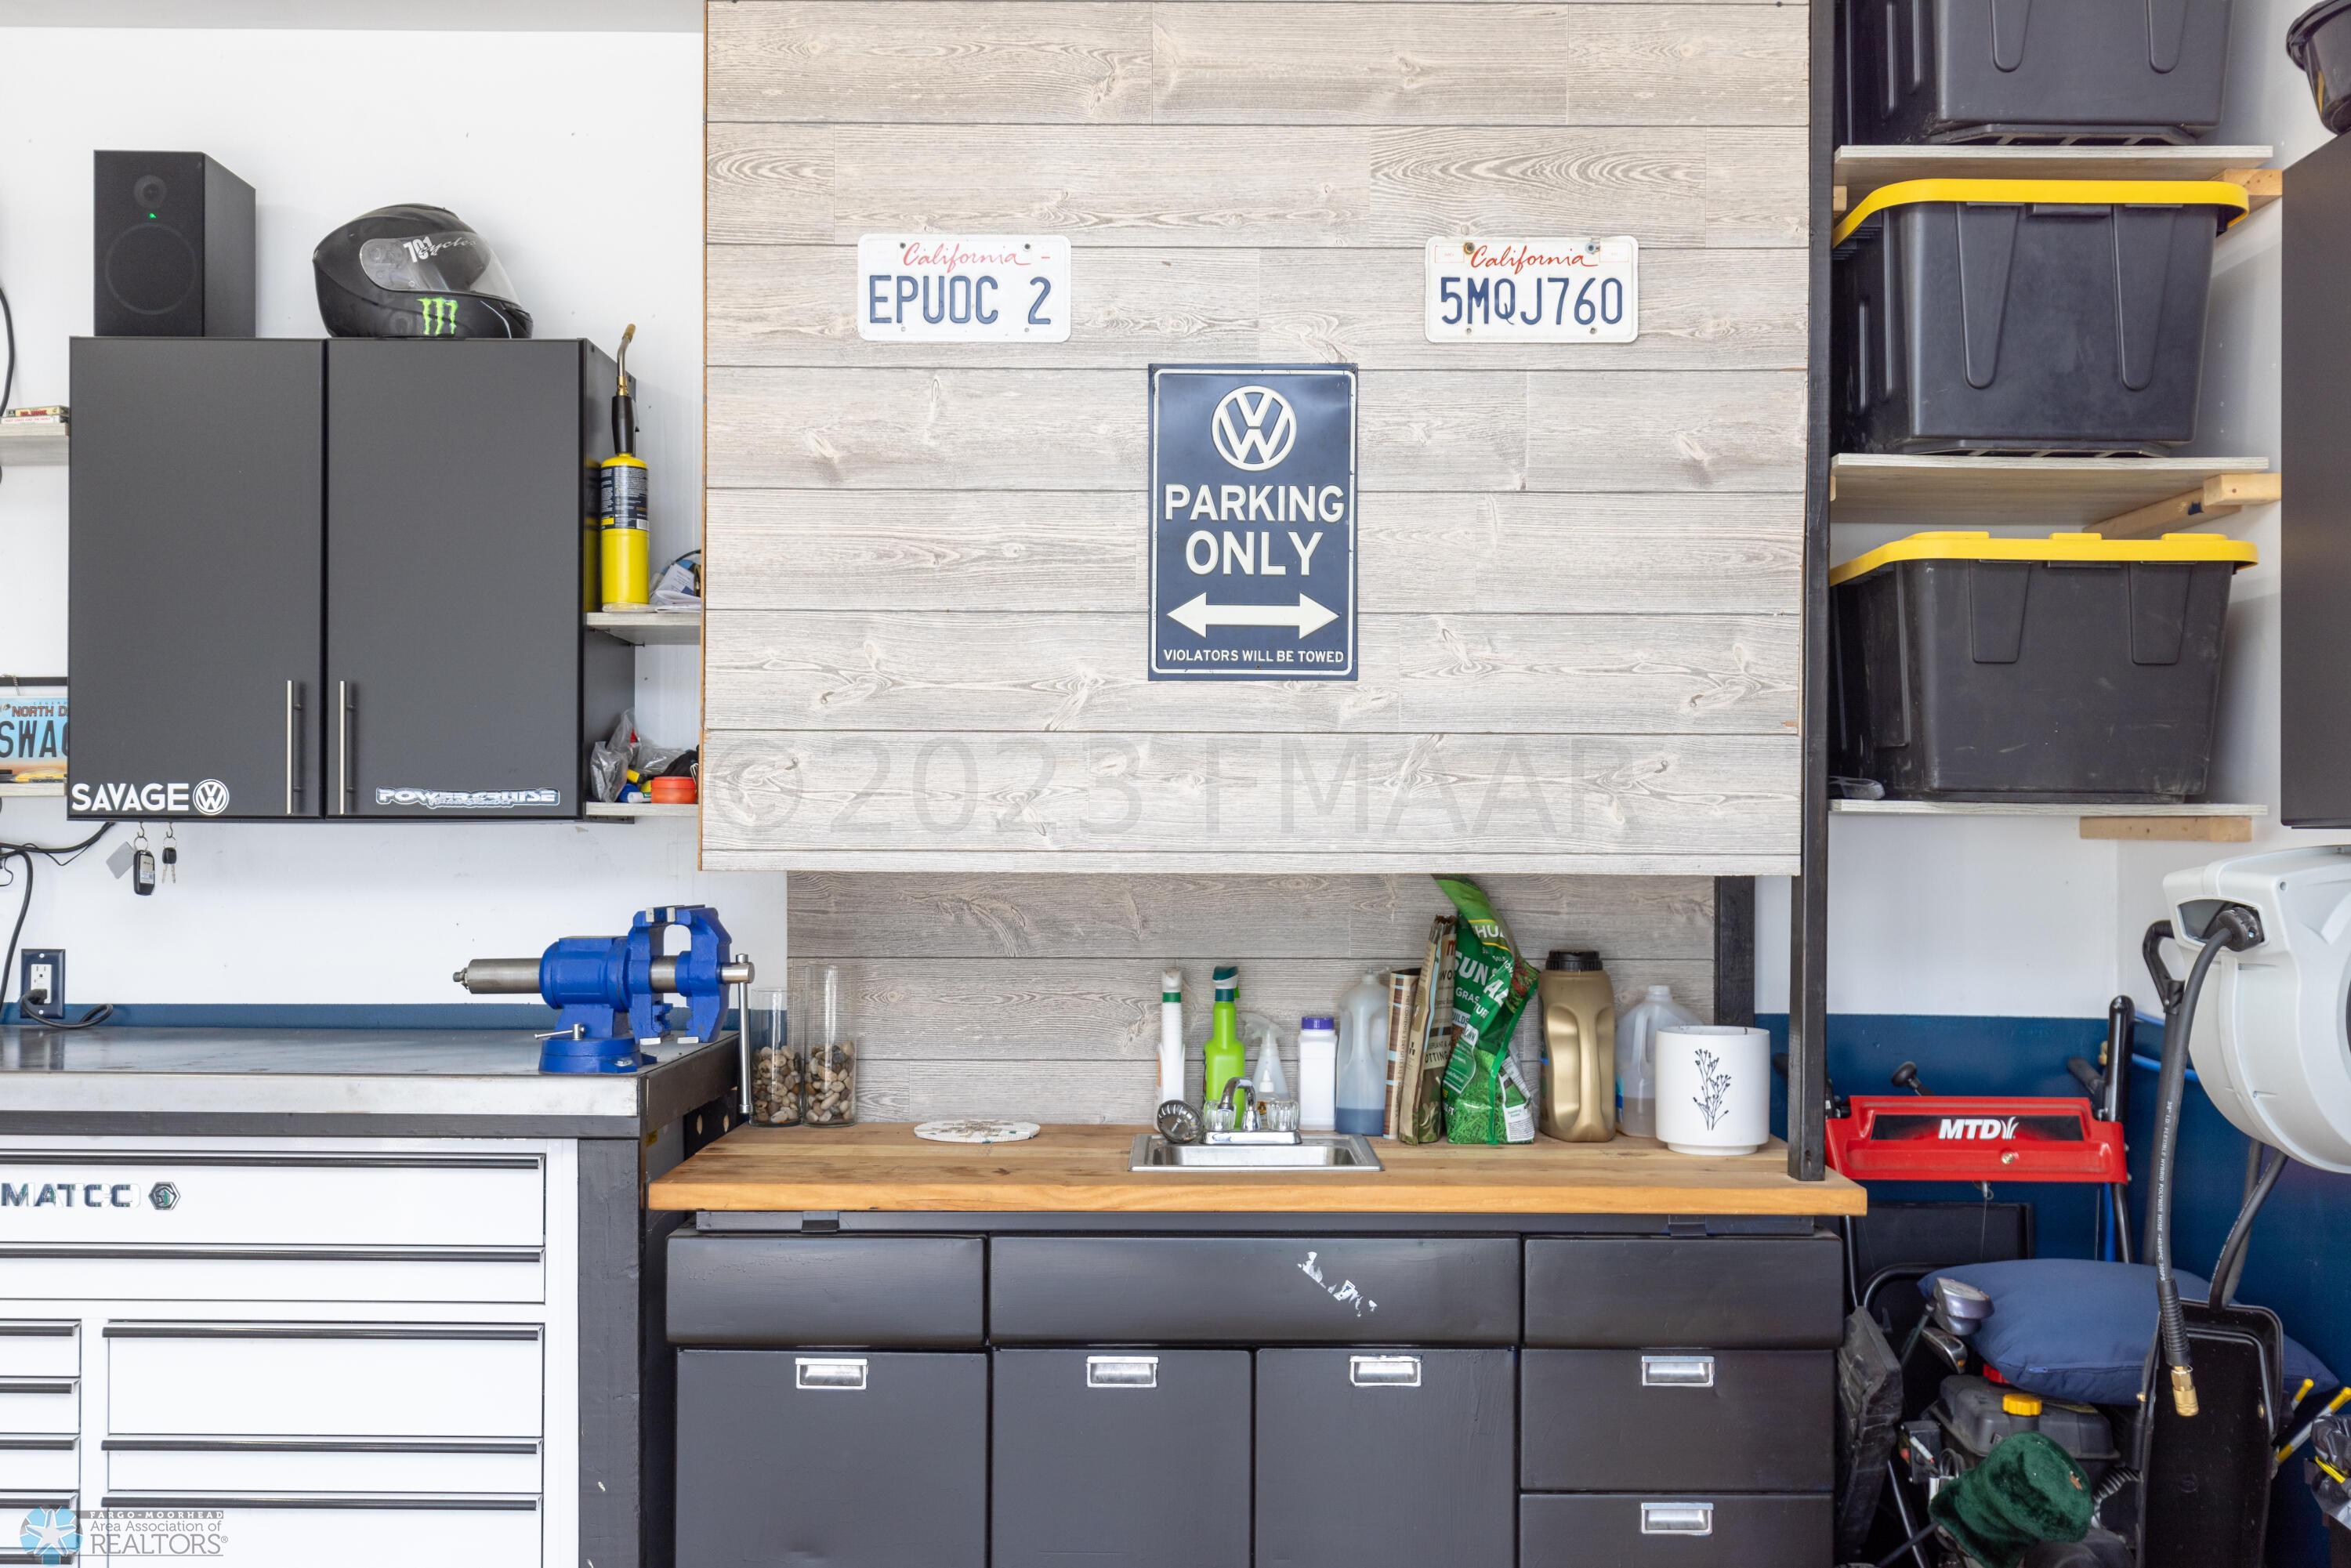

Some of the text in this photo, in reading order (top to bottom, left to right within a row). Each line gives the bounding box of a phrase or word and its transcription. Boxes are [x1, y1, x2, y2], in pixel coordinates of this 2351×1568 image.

[903, 242, 1031, 273] California
[1470, 244, 1599, 274] California
[869, 275, 1052, 324] EPUOC 2
[1440, 277, 1623, 325] 5MQJ760
[1164, 483, 1345, 523] PARKING
[1185, 530, 1324, 576] ONLY
[1163, 649, 1344, 663] VIOLATORS WILL BE TOWED
[12, 705, 54, 717] NORTH
[71, 783, 189, 811] SAVAGE
[1938, 1118, 2001, 1139] MTD
[2161, 1127, 2169, 1157] FLEXIBLE
